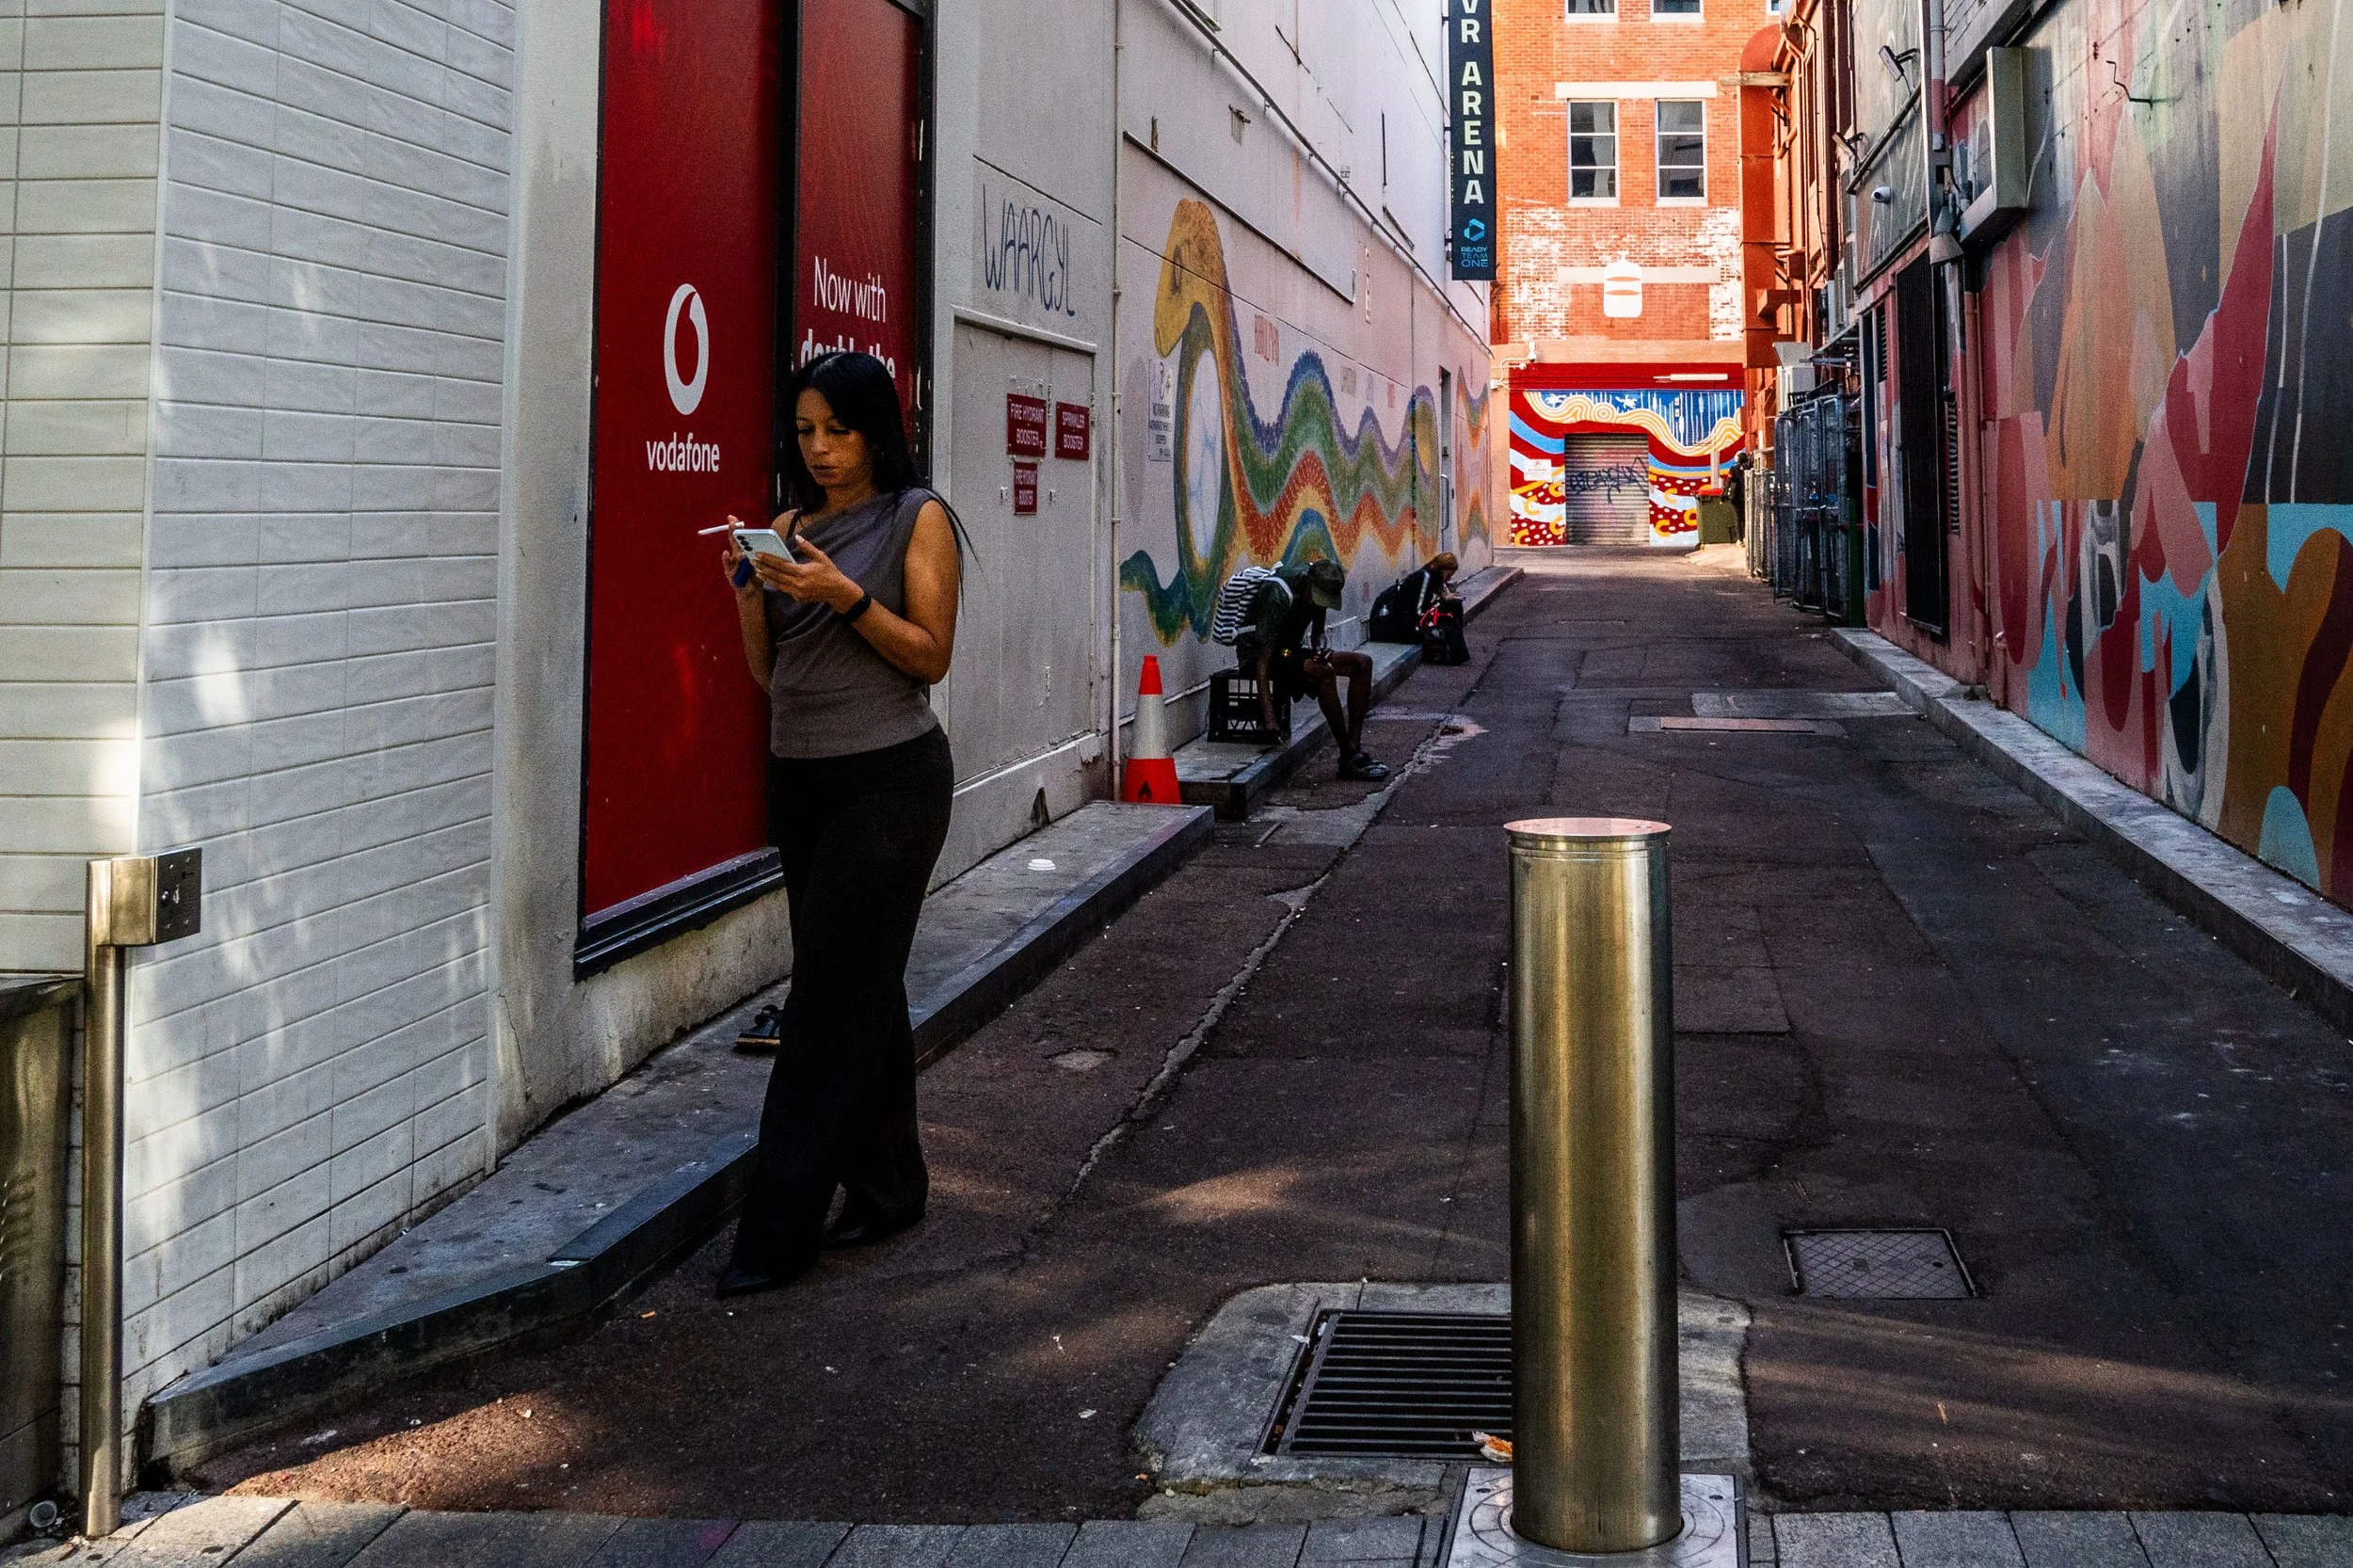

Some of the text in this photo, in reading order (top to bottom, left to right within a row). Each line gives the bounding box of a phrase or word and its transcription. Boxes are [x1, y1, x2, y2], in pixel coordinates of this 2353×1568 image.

[1461, 0, 1484, 204] VR ARENA
[1461, 259, 1488, 267] ONE
[814, 255, 887, 323] Now with
[1010, 403, 1045, 424] FIRE HYDRANT
[1062, 411, 1085, 429] SPRINKLER
[1016, 428, 1040, 446] BOOSTER
[1064, 434, 1083, 450] BOOSTER
[647, 432, 720, 472] vodafone
